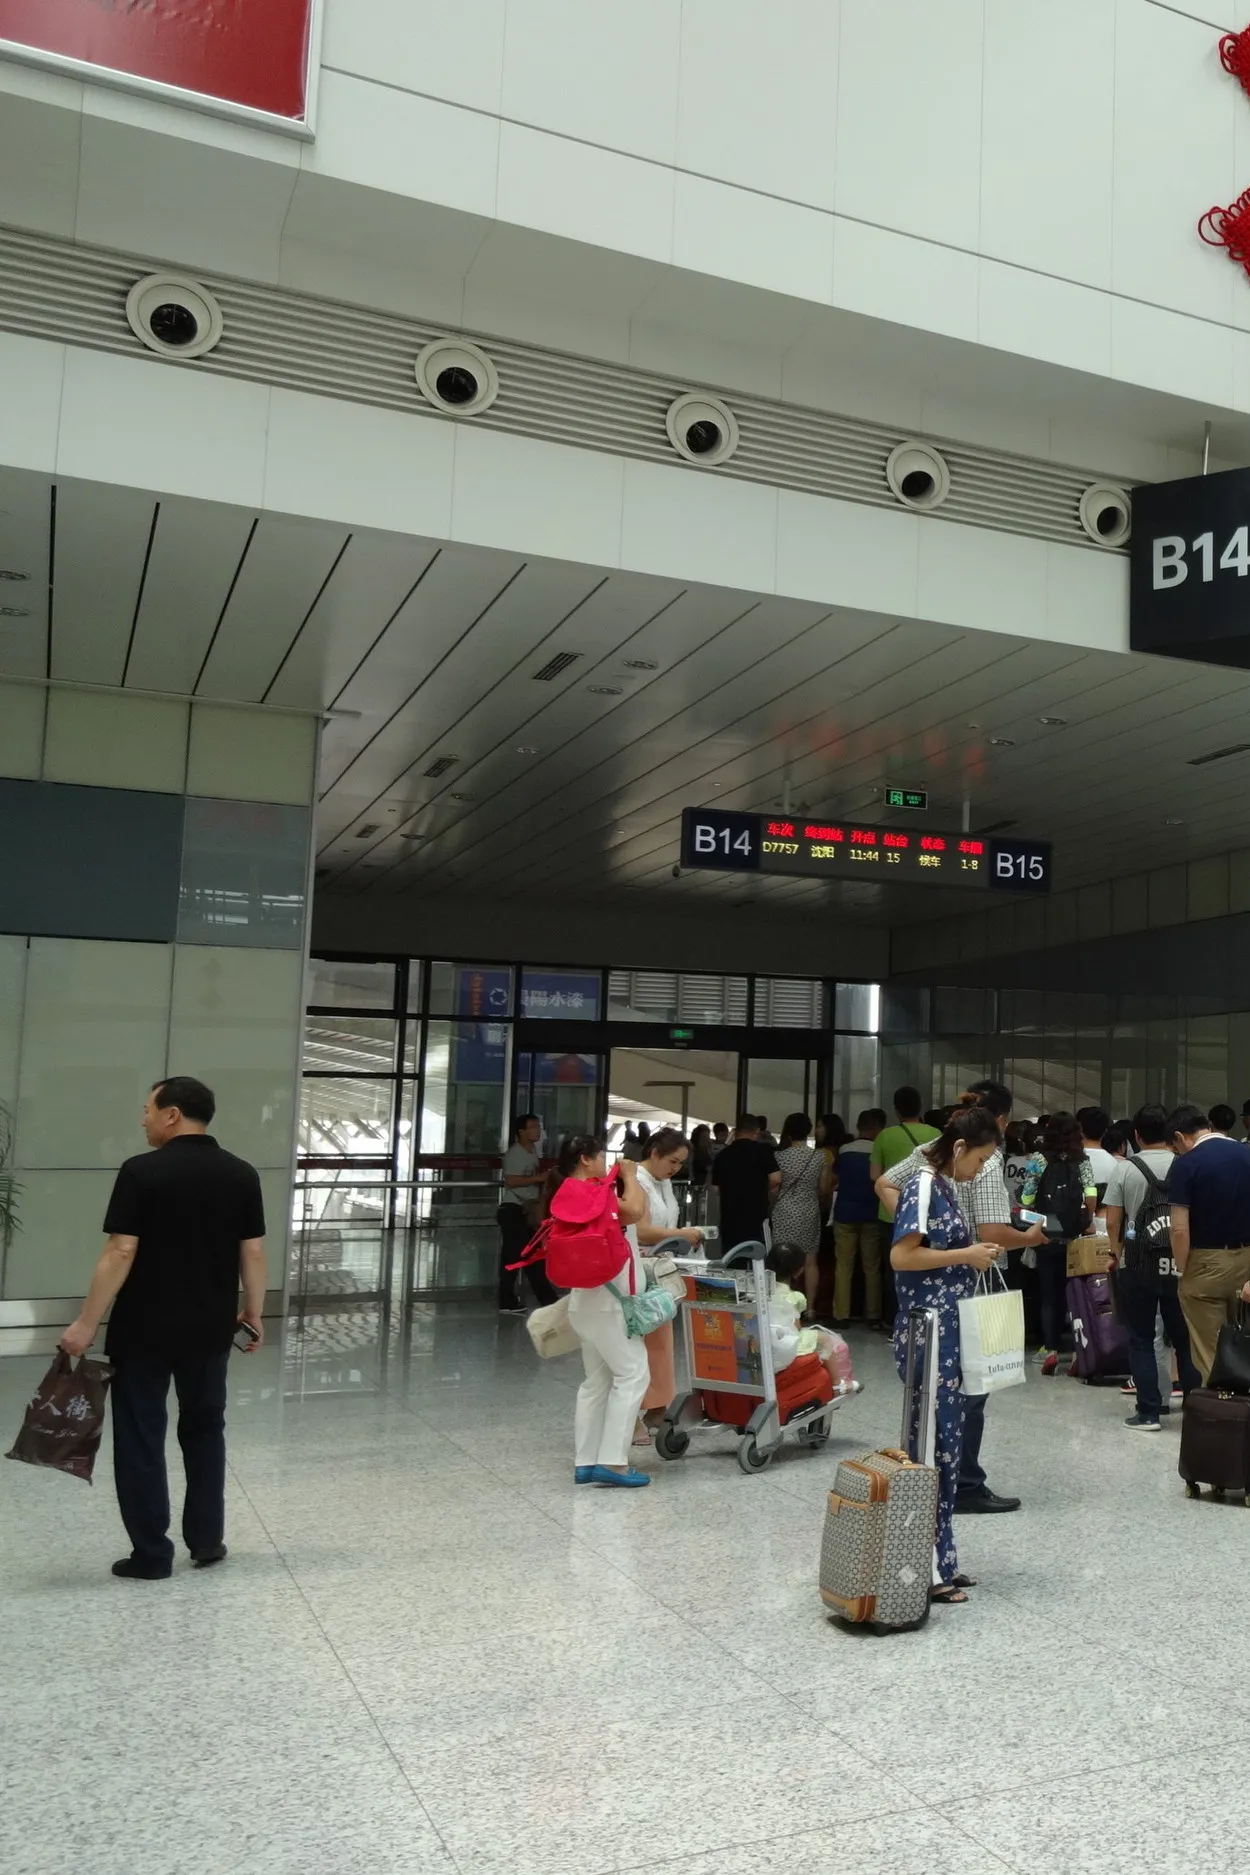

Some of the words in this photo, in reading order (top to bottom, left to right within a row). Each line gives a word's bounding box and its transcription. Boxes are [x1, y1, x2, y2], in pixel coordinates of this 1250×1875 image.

[695, 825, 752, 856] B14
[767, 822, 795, 838] 车次
[851, 830, 876, 845] 开点
[762, 841, 800, 855] D7757
[811, 845, 835, 858] 沈阳
[850, 849, 879, 862] 11:44
[887, 853, 901, 863] 15
[918, 854, 941, 868] 候车
[961, 859, 979, 870] 1-8
[997, 852, 1044, 880] B15
